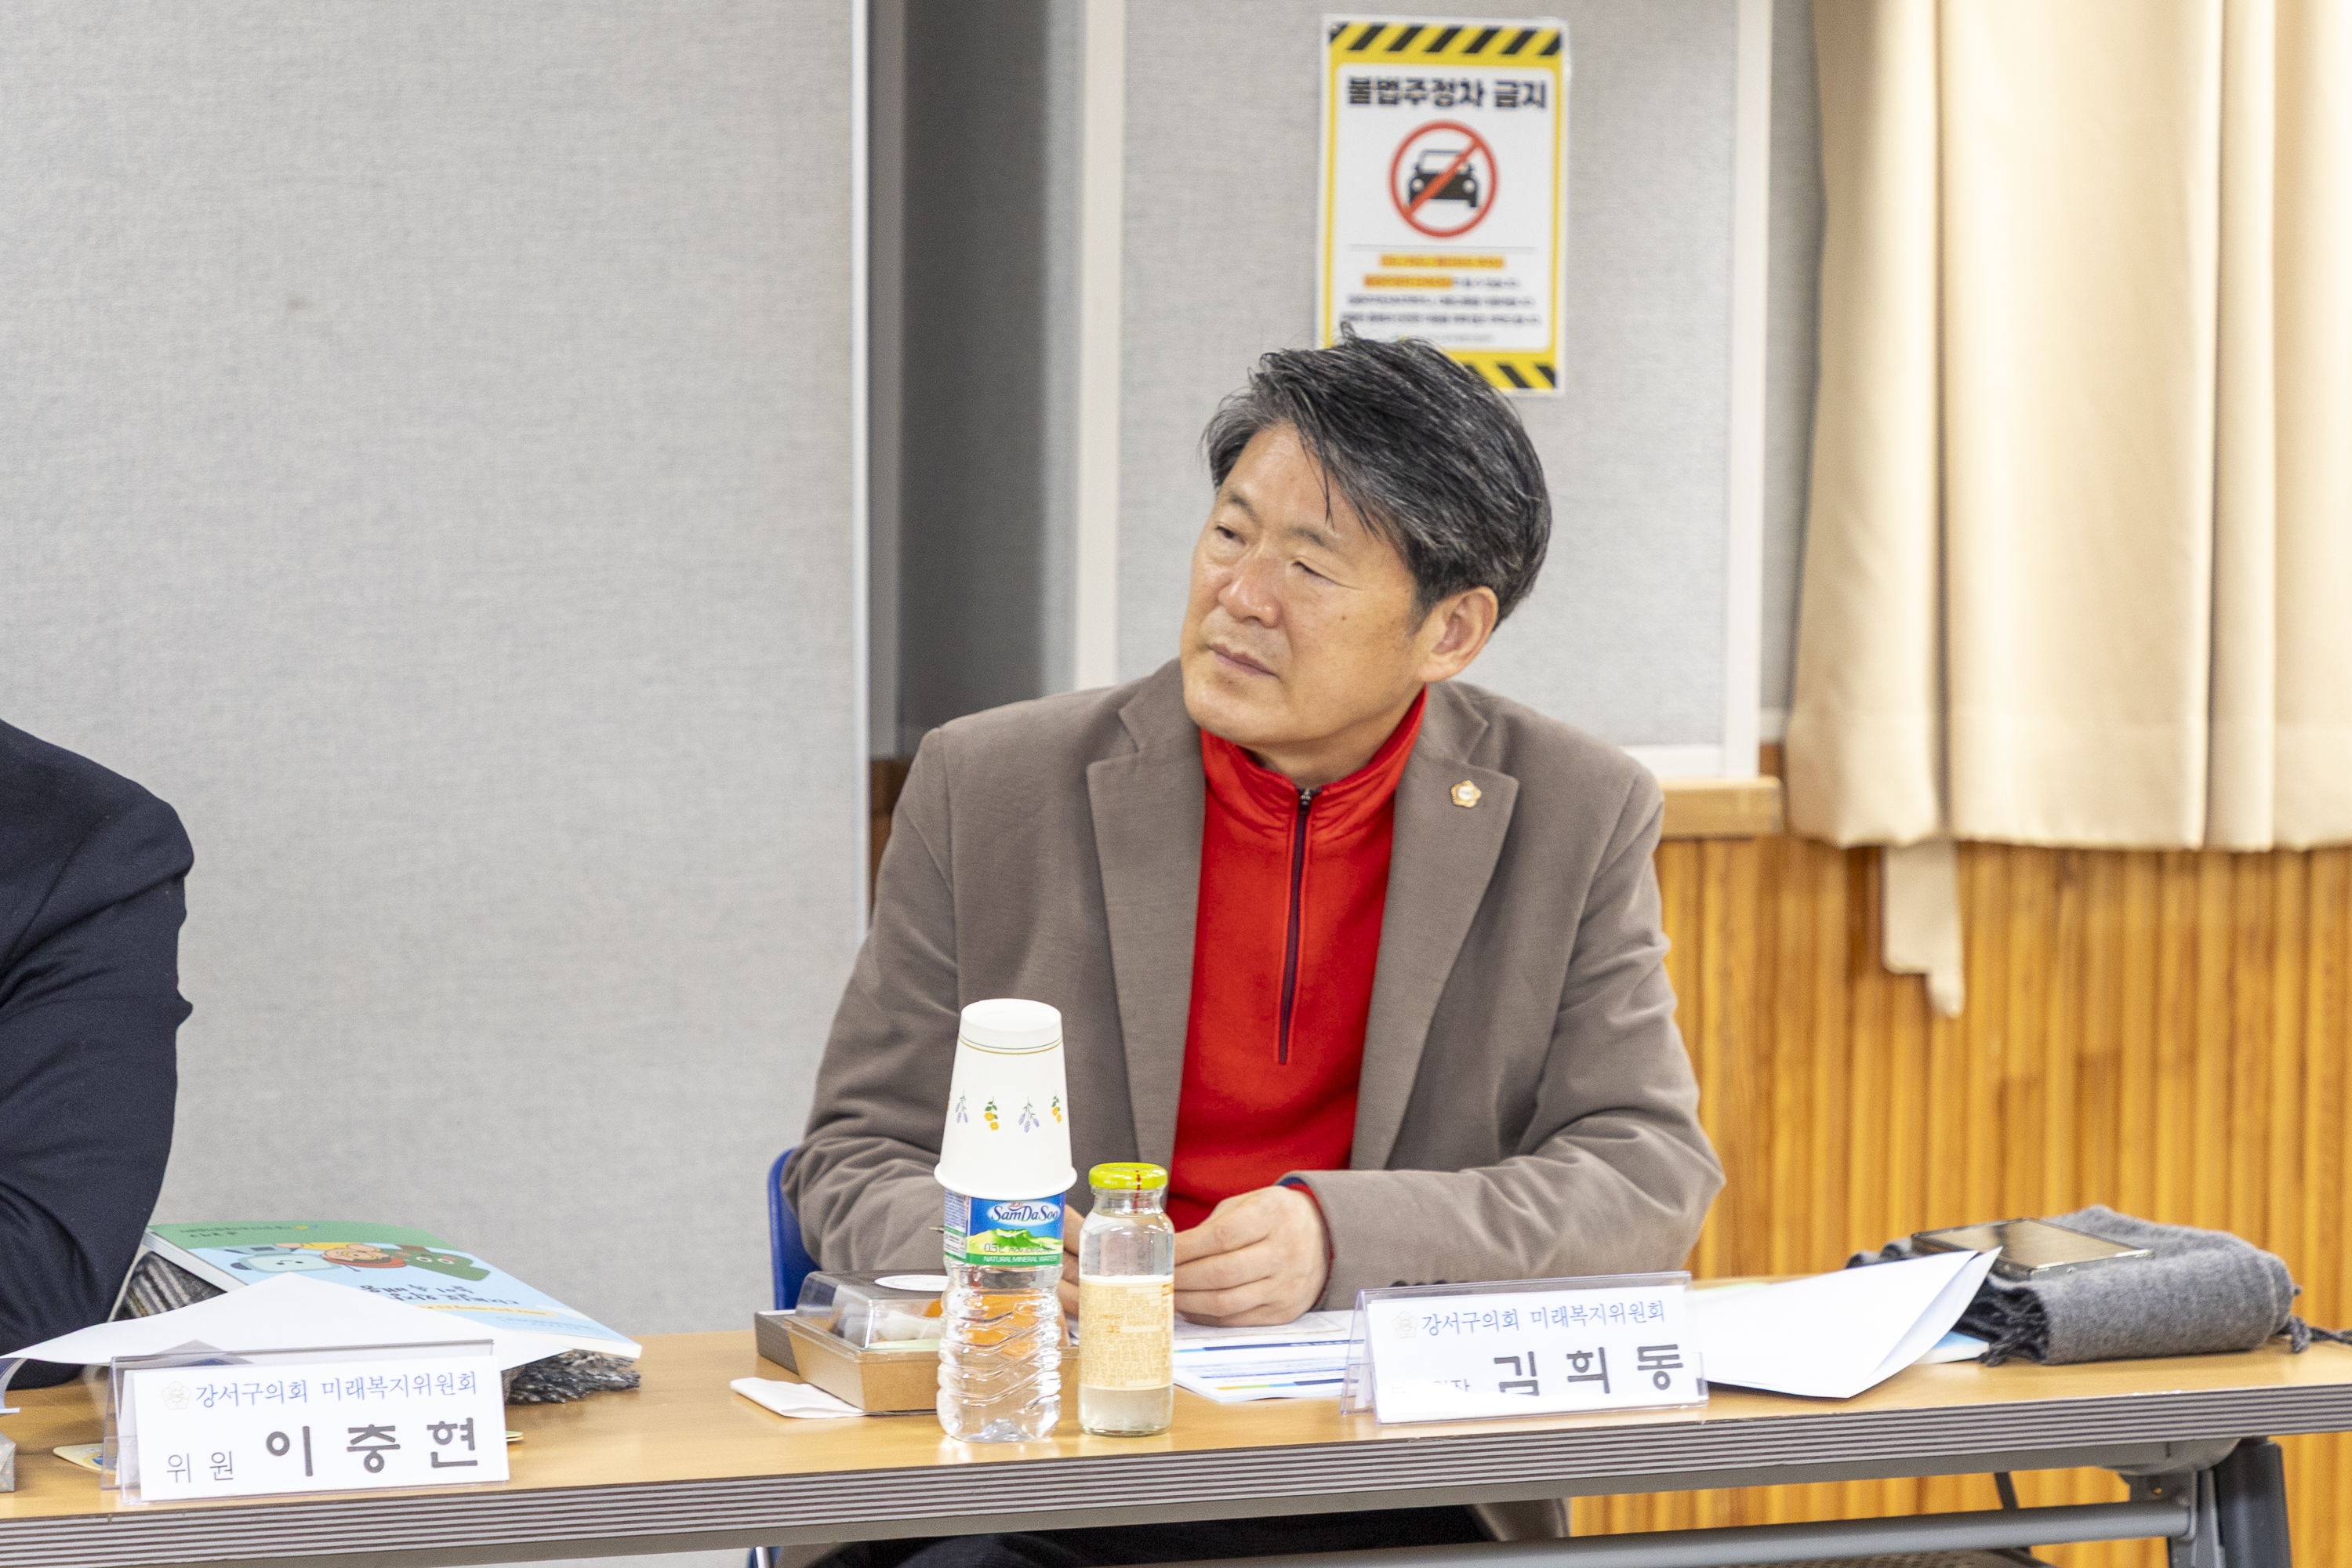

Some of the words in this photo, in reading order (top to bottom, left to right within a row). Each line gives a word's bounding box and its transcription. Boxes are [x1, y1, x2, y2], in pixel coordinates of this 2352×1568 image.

[1348, 76, 1485, 108] 불법주정차
[1494, 79, 1548, 109] 금지
[1422, 1308, 1519, 1336] 강서구의회
[1531, 1300, 1665, 1330] 미래복지위원회
[196, 1379, 308, 1409] 강서구의회
[321, 1370, 477, 1403] 미래복지위원회
